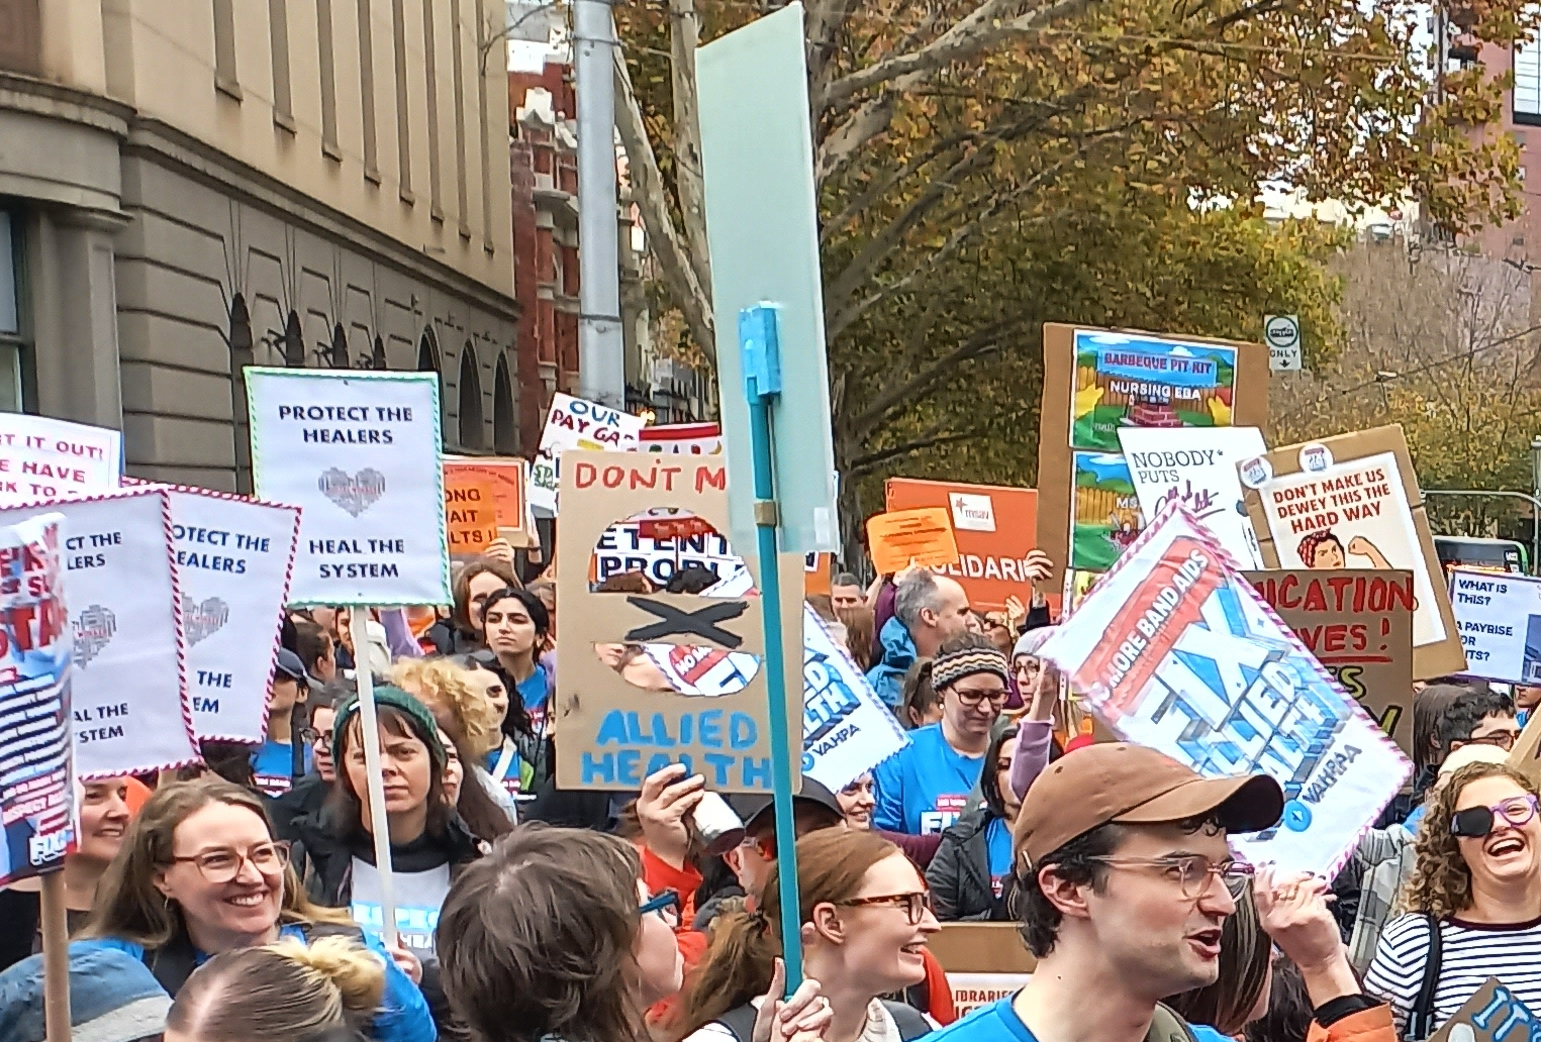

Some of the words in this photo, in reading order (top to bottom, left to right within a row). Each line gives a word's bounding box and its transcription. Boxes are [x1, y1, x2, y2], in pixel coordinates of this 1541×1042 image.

[1104, 352, 1167, 370] BARBEQUE
[1170, 357, 1191, 373] PIT
[1192, 360, 1213, 375] KIT
[1110, 380, 1170, 398] NURSING
[1174, 387, 1201, 400] EBA
[279, 405, 370, 421] PROTECT
[376, 406, 413, 422] THE
[551, 409, 590, 434] PAY
[569, 400, 620, 427] OUR
[26, 435, 43, 450] IT
[303, 428, 393, 444] HEALERS
[22, 461, 86, 484] HAVE
[575, 458, 682, 492] DON'T
[1139, 470, 1180, 484] PUTS
[1273, 483, 1317, 504] DON'T
[1322, 474, 1362, 495] MAKE
[1365, 468, 1385, 483] US
[1277, 497, 1326, 519] DEWEY
[1330, 490, 1362, 507] THIS
[1364, 483, 1391, 500] THE
[1291, 512, 1339, 534] HARD
[1343, 501, 1382, 522] WAY
[90, 531, 122, 549] THE
[235, 533, 270, 552] THE
[309, 539, 361, 555] HEAL
[366, 538, 404, 553] THE
[319, 563, 399, 579] SYSTEM
[1458, 578, 1494, 593] WHAT
[1495, 583, 1508, 594] IS
[1457, 592, 1492, 607] THIS?
[1108, 634, 1149, 685] MORE
[1144, 588, 1179, 636] BAND
[1175, 548, 1209, 592] AIDS
[197, 670, 232, 689] THE
[97, 702, 129, 719] THE
[595, 709, 758, 748] ALLIED
[811, 723, 861, 756] VAHPA
[1301, 743, 1363, 804] VAHPA
